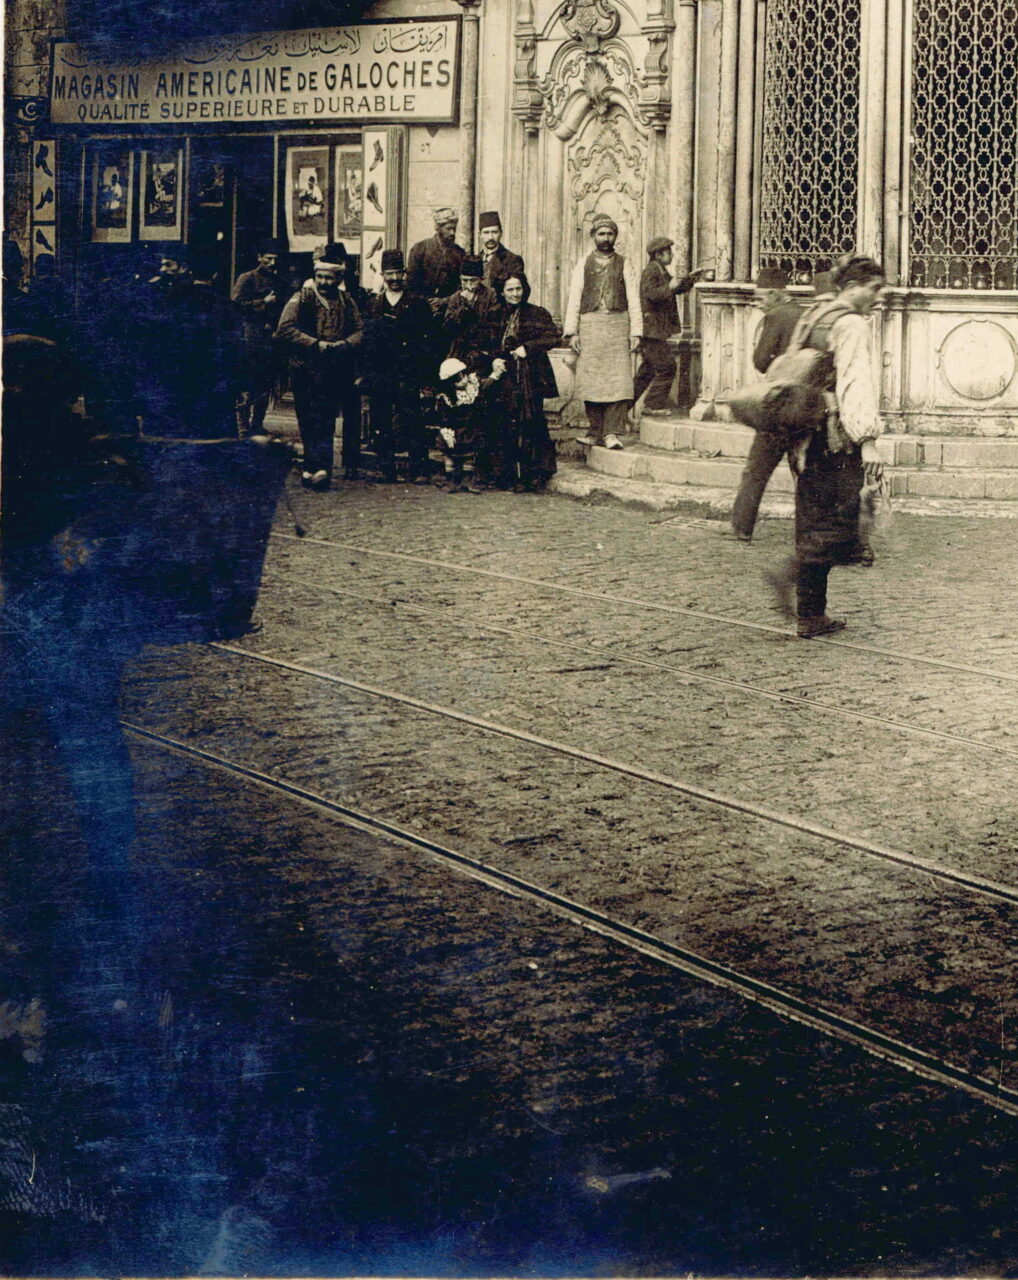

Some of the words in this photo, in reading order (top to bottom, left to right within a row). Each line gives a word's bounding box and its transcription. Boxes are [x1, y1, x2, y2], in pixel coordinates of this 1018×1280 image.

[54, 73, 140, 100] MAGASIN
[156, 65, 292, 98] AMERICAINE
[298, 71, 318, 91] DE
[325, 58, 451, 91] GALOCHES
[77, 99, 150, 122] QUALITÉ
[160, 98, 287, 119] SUPERIEURE
[293, 100, 309, 115] ET
[314, 94, 416, 113] DURABLE
